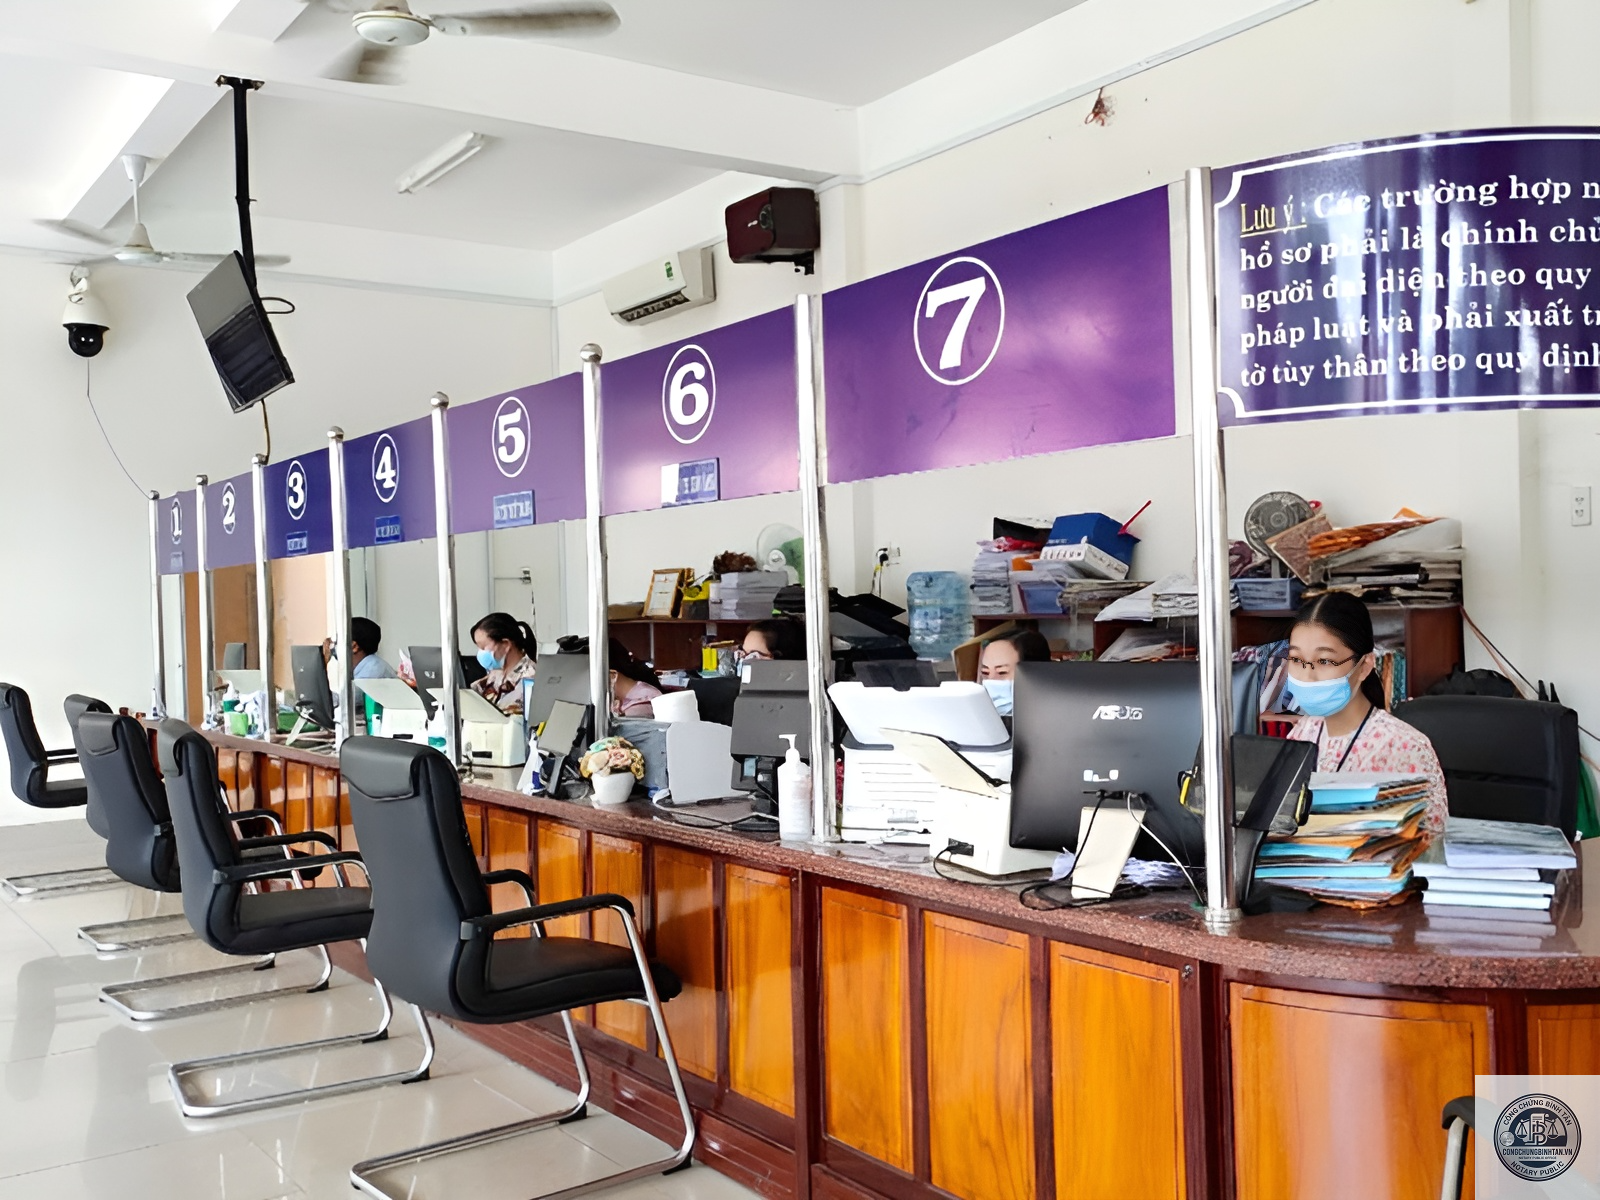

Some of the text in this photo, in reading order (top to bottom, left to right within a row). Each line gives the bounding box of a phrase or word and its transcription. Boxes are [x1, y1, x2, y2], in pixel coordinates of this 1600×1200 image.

[1240, 203, 1275, 233] Lưu
[1381, 178, 1498, 208] trường
[1508, 174, 1572, 205] hợp
[1240, 240, 1273, 272] hồ
[1281, 242, 1313, 265] sơ
[1441, 220, 1539, 249] chính
[1240, 278, 1314, 313] người
[1376, 267, 1445, 298] diện
[1456, 262, 1526, 289] theo
[1535, 267, 1592, 291] quy
[925, 275, 987, 371] 7
[1240, 321, 1306, 355] pháp
[1380, 308, 1414, 334] và
[1428, 301, 1494, 334] phải
[1504, 297, 1575, 328] xuất
[669, 361, 710, 426] 6
[1240, 362, 1267, 388] tờ
[1272, 359, 1315, 387] tùy
[1323, 352, 1388, 380] thân
[1398, 348, 1467, 374] theo
[1475, 350, 1532, 376] quy
[497, 407, 526, 464] 5
[288, 471, 304, 510] 3
[375, 445, 396, 489] 4
[171, 507, 183, 537] 1
[222, 490, 236, 526] 2
